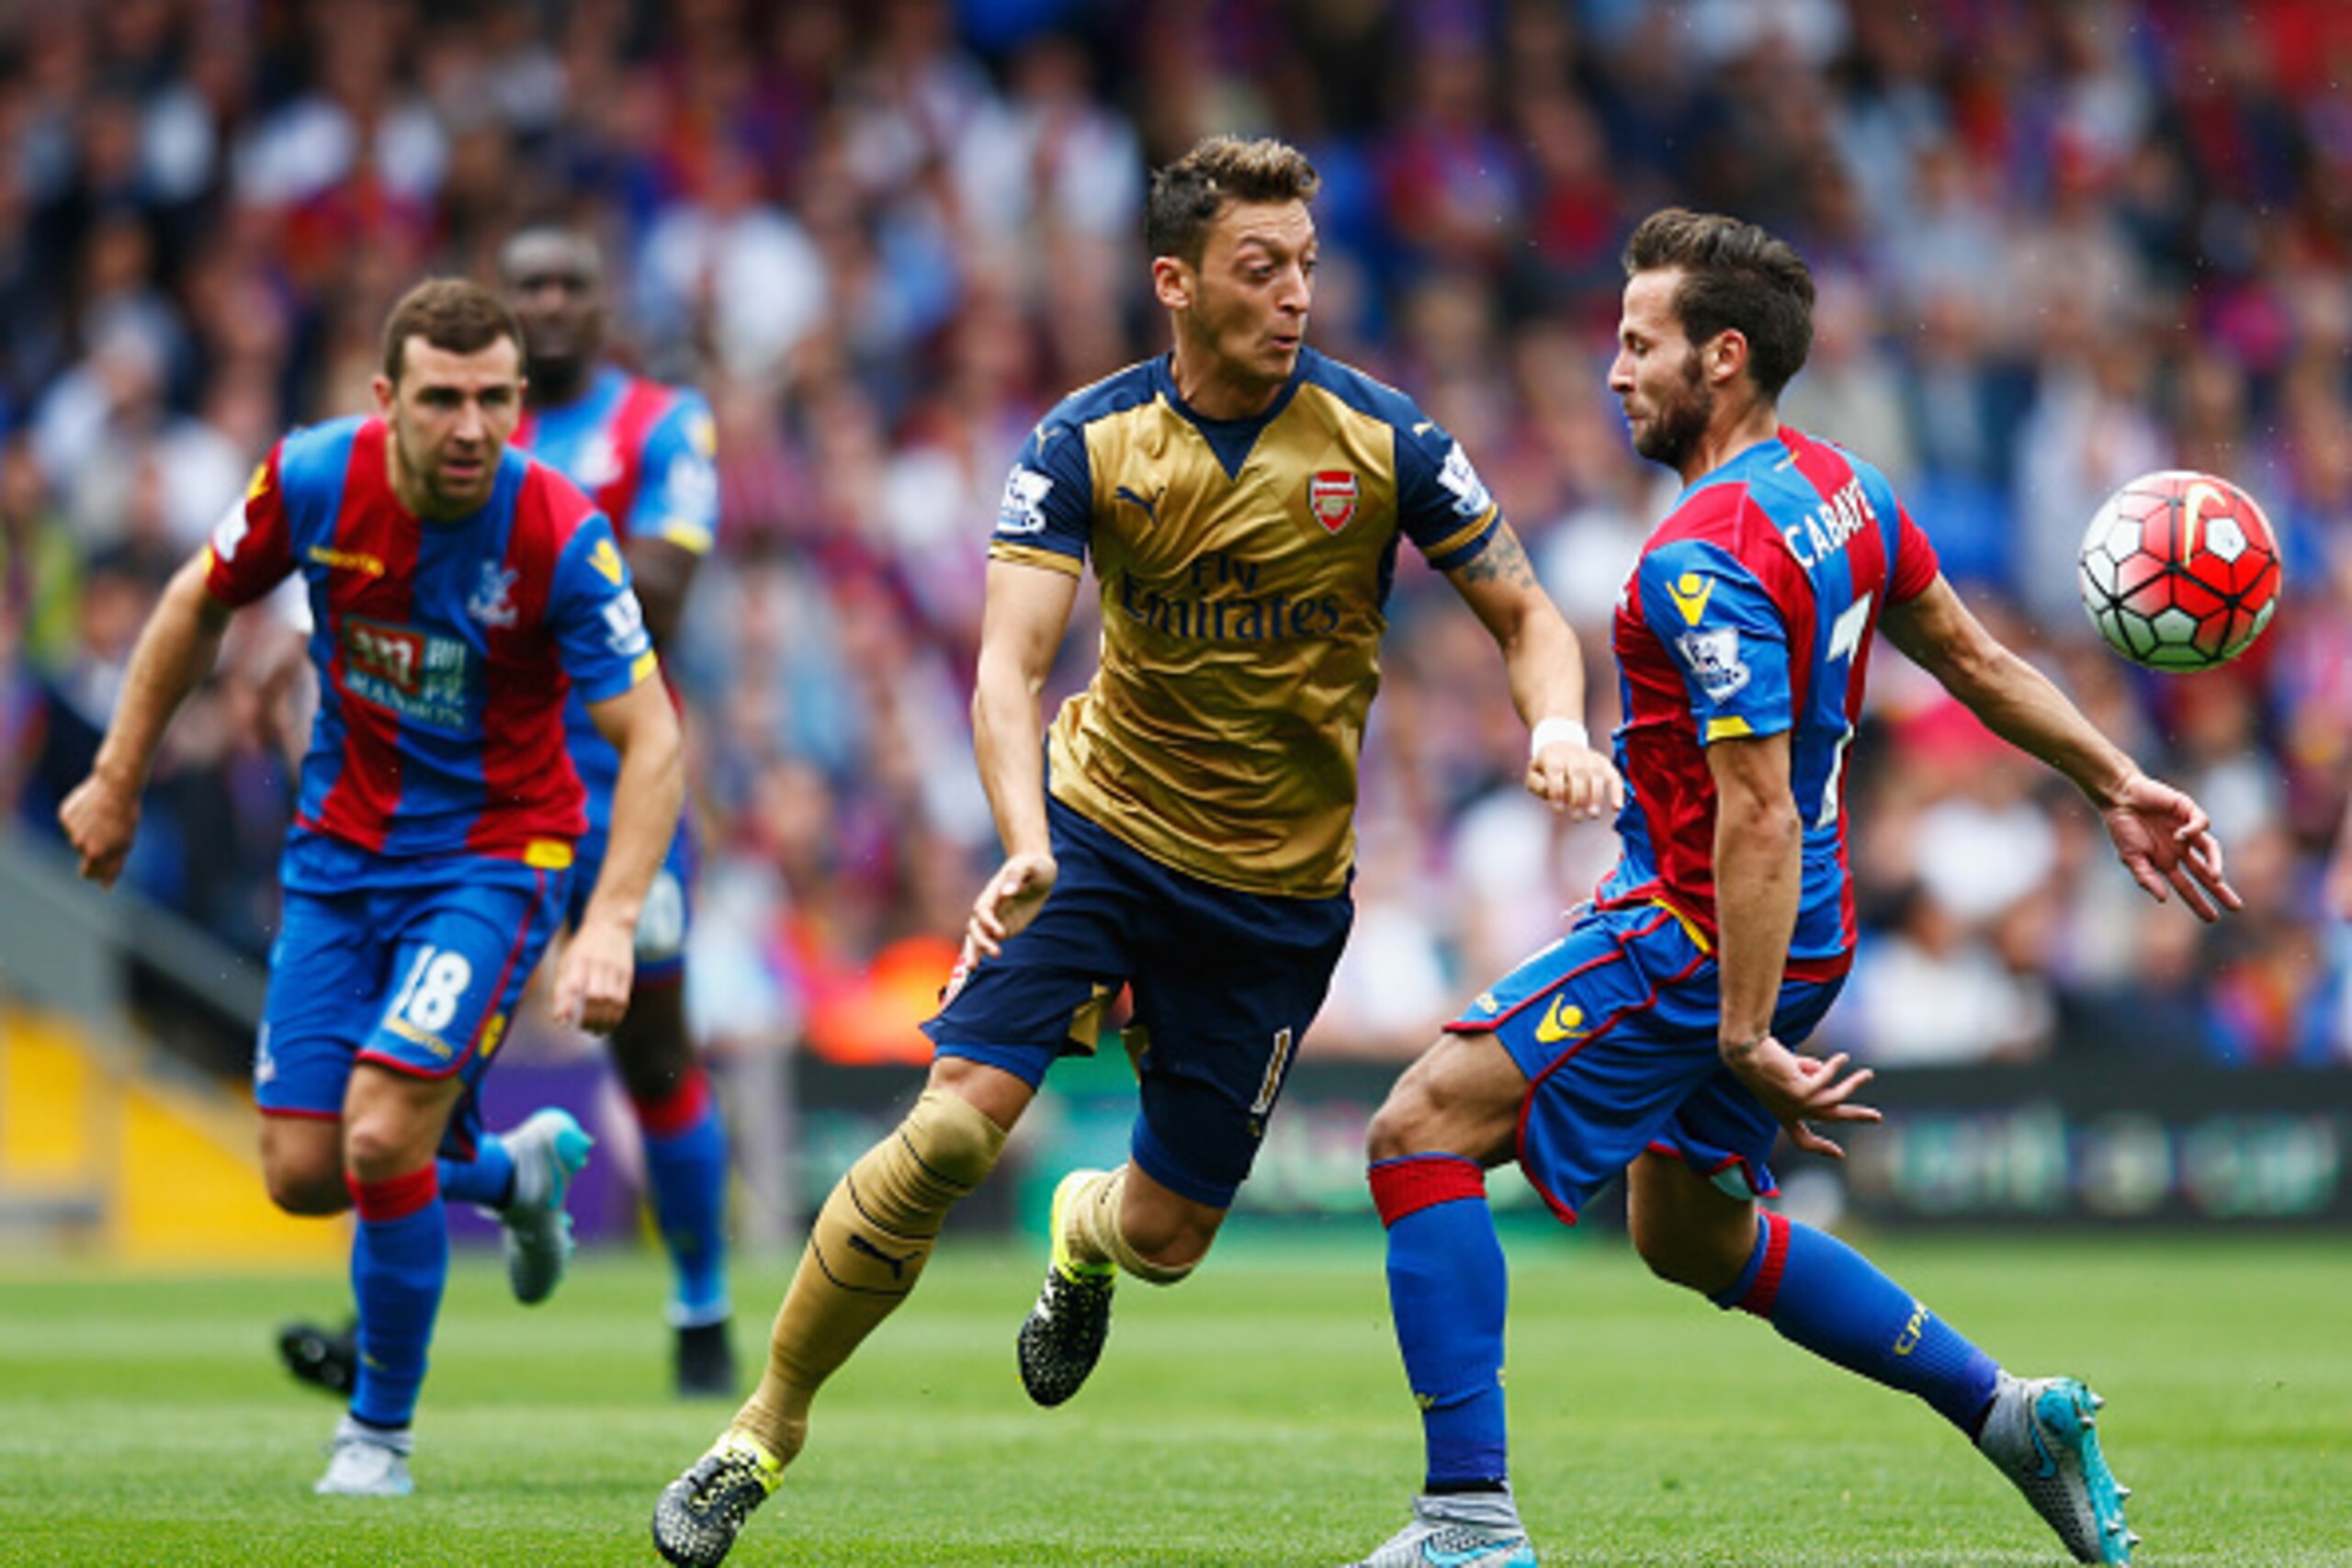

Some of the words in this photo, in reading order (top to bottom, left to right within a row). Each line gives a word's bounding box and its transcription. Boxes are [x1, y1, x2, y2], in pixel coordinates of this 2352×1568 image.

[1123, 566, 1340, 639] Emirates
[1192, 553, 1260, 593] Fly
[382, 944, 472, 1030] 18
